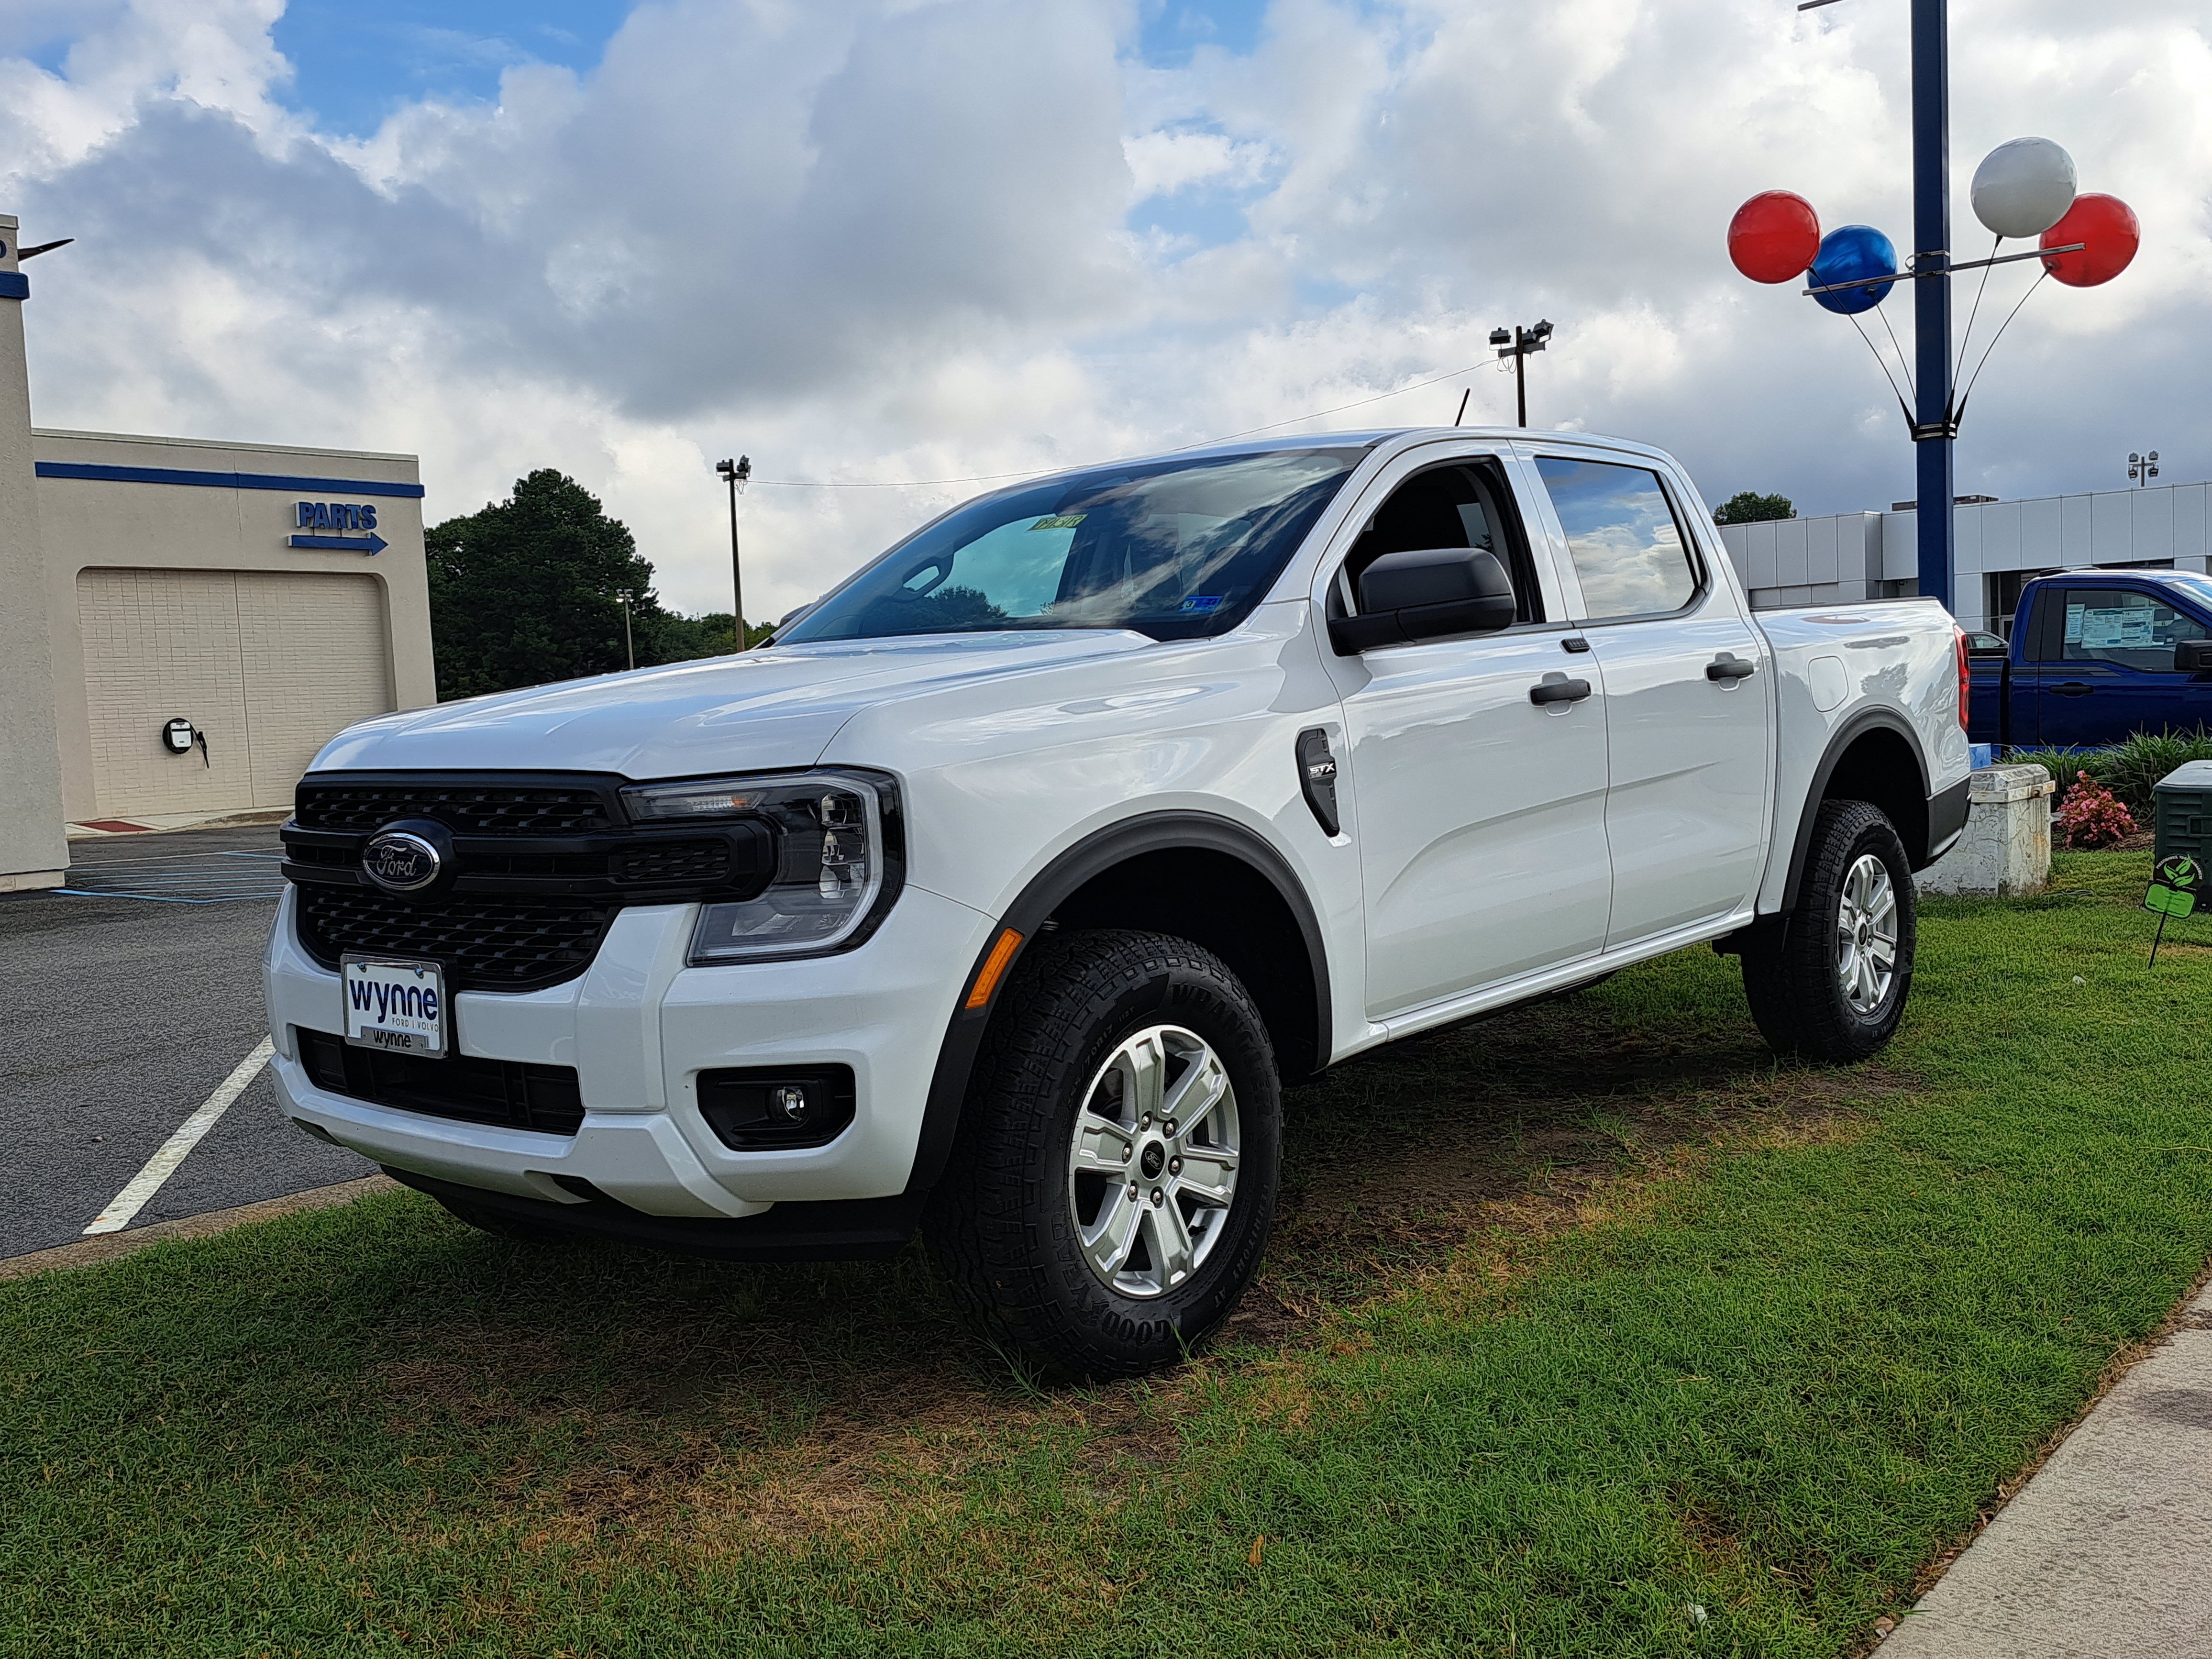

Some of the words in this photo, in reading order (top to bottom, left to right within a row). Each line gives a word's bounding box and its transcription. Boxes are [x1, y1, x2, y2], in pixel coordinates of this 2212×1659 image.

[296, 501, 377, 530] PARTS
[1310, 763, 1335, 774] STX
[376, 844, 417, 877] Ford
[349, 979, 438, 1024] wynne
[392, 1017, 409, 1028] FORD
[417, 1020, 439, 1032] VOLVO
[373, 1029, 412, 1049] wynne
[1147, 1153, 1160, 1168] Ford
[1231, 1183, 1272, 1284] TERRITORY
[1051, 1211, 1172, 1346] GOODYEAR
[1214, 1286, 1227, 1309] AT
